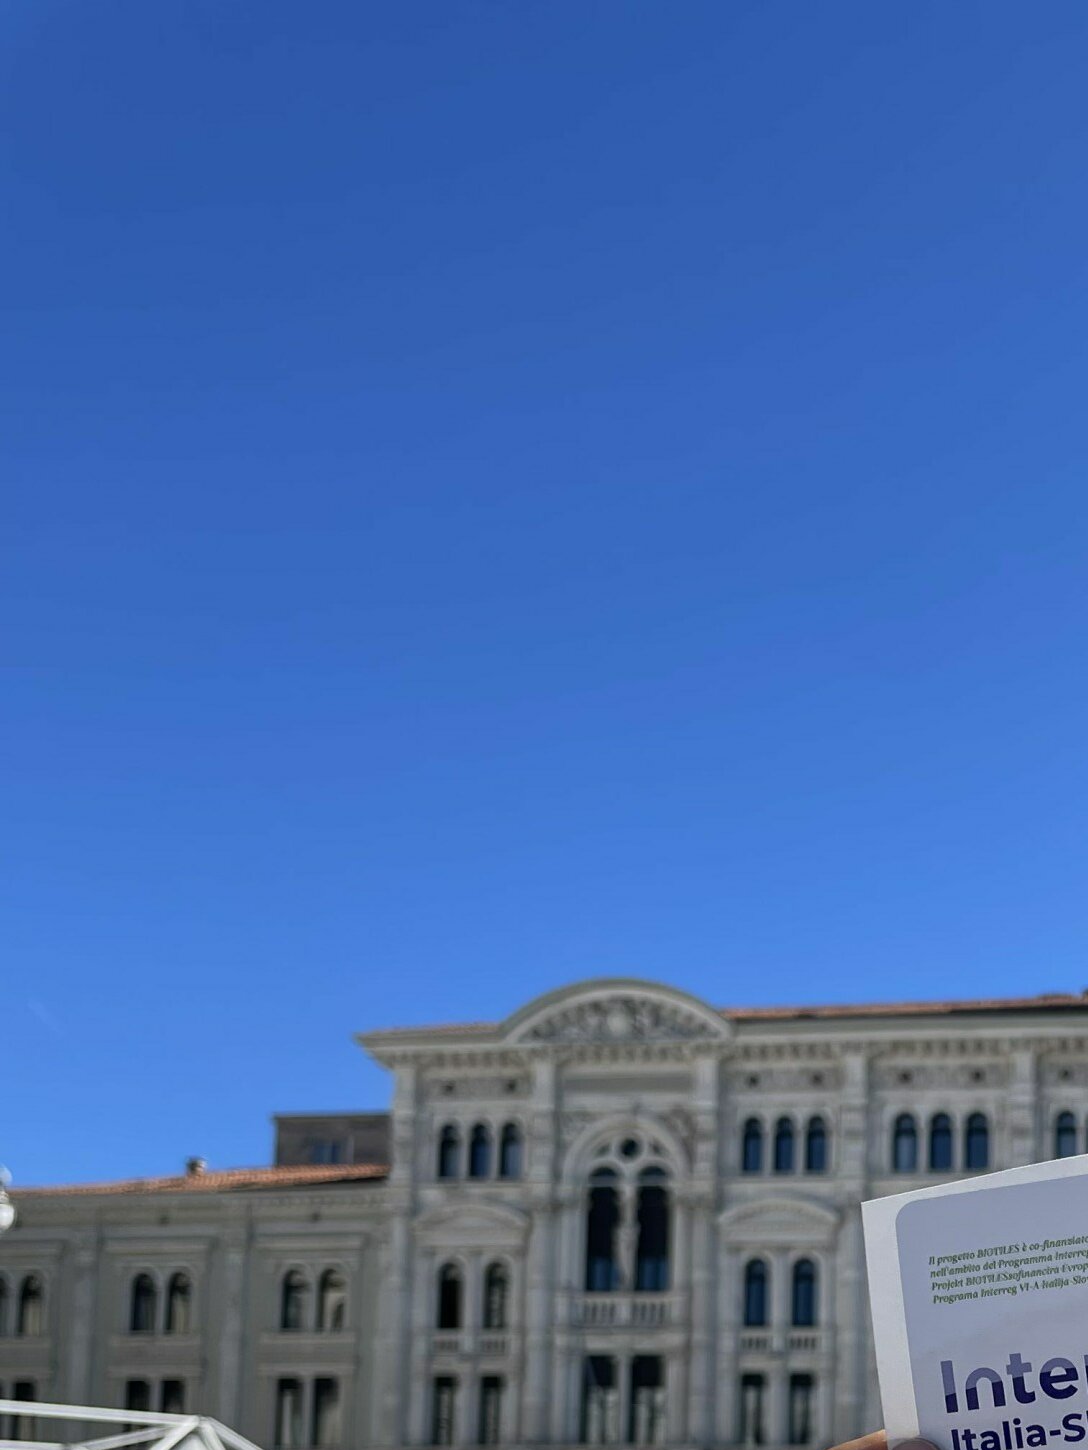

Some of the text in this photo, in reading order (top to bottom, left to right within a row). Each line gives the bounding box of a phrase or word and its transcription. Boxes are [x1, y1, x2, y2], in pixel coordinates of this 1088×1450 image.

[937, 1252, 975, 1267] progetto
[977, 1244, 1020, 1259] BIOTILES
[983, 1260, 996, 1271] del
[998, 1254, 1053, 1269] Programma
[931, 1279, 963, 1292] Projekt
[933, 1291, 978, 1304] Programa
[981, 1286, 1017, 1298] Interreg
